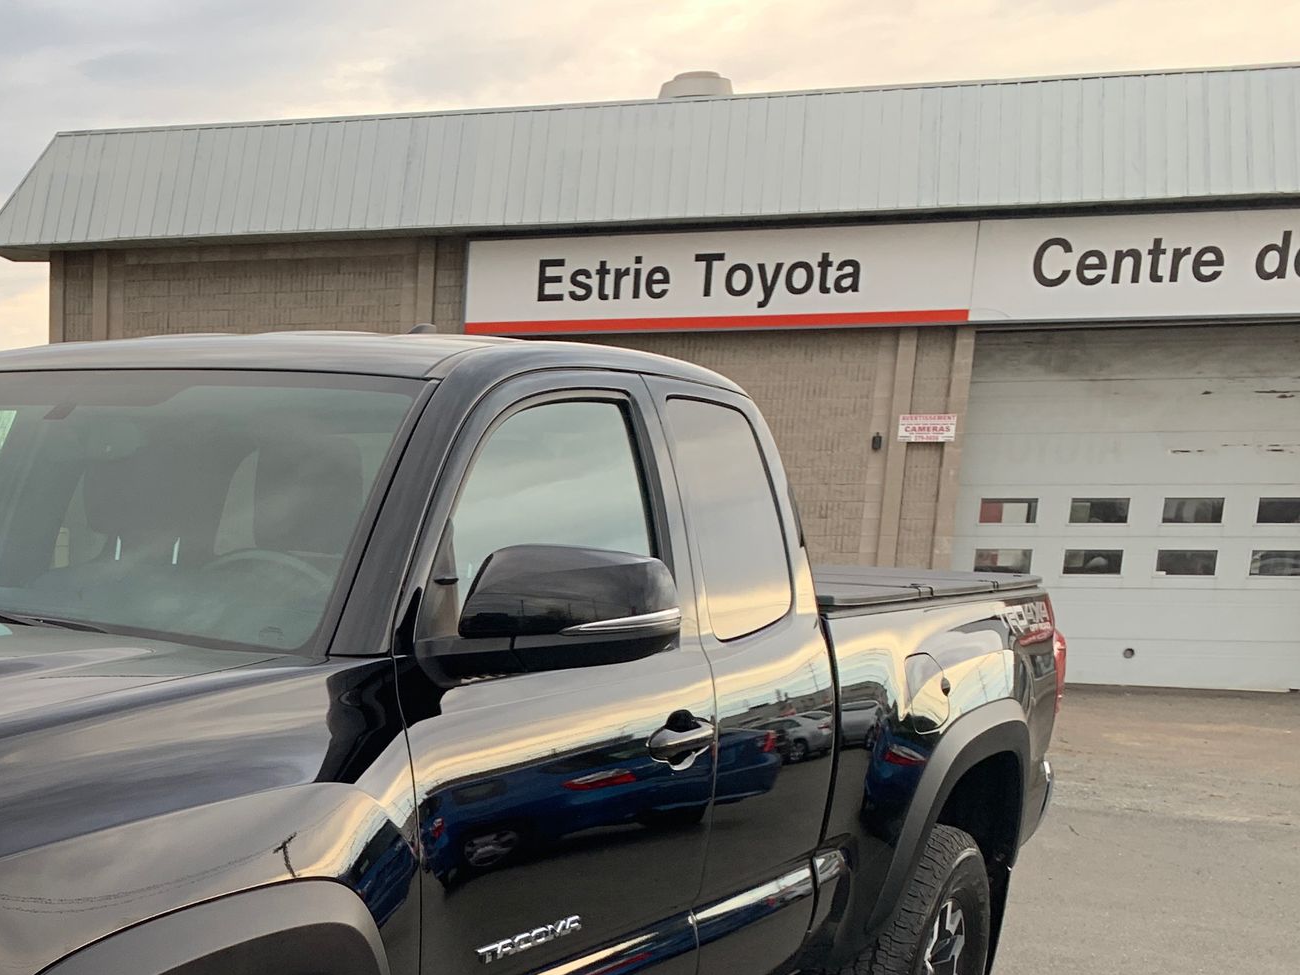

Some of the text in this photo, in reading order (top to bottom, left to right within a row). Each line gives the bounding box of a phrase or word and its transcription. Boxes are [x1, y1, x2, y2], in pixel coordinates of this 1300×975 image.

[537, 252, 861, 309] Estrie Toyota
[1033, 230, 1300, 287] Centre d
[904, 425, 951, 433] CAMERAS
[476, 915, 581, 963] TACOMA
